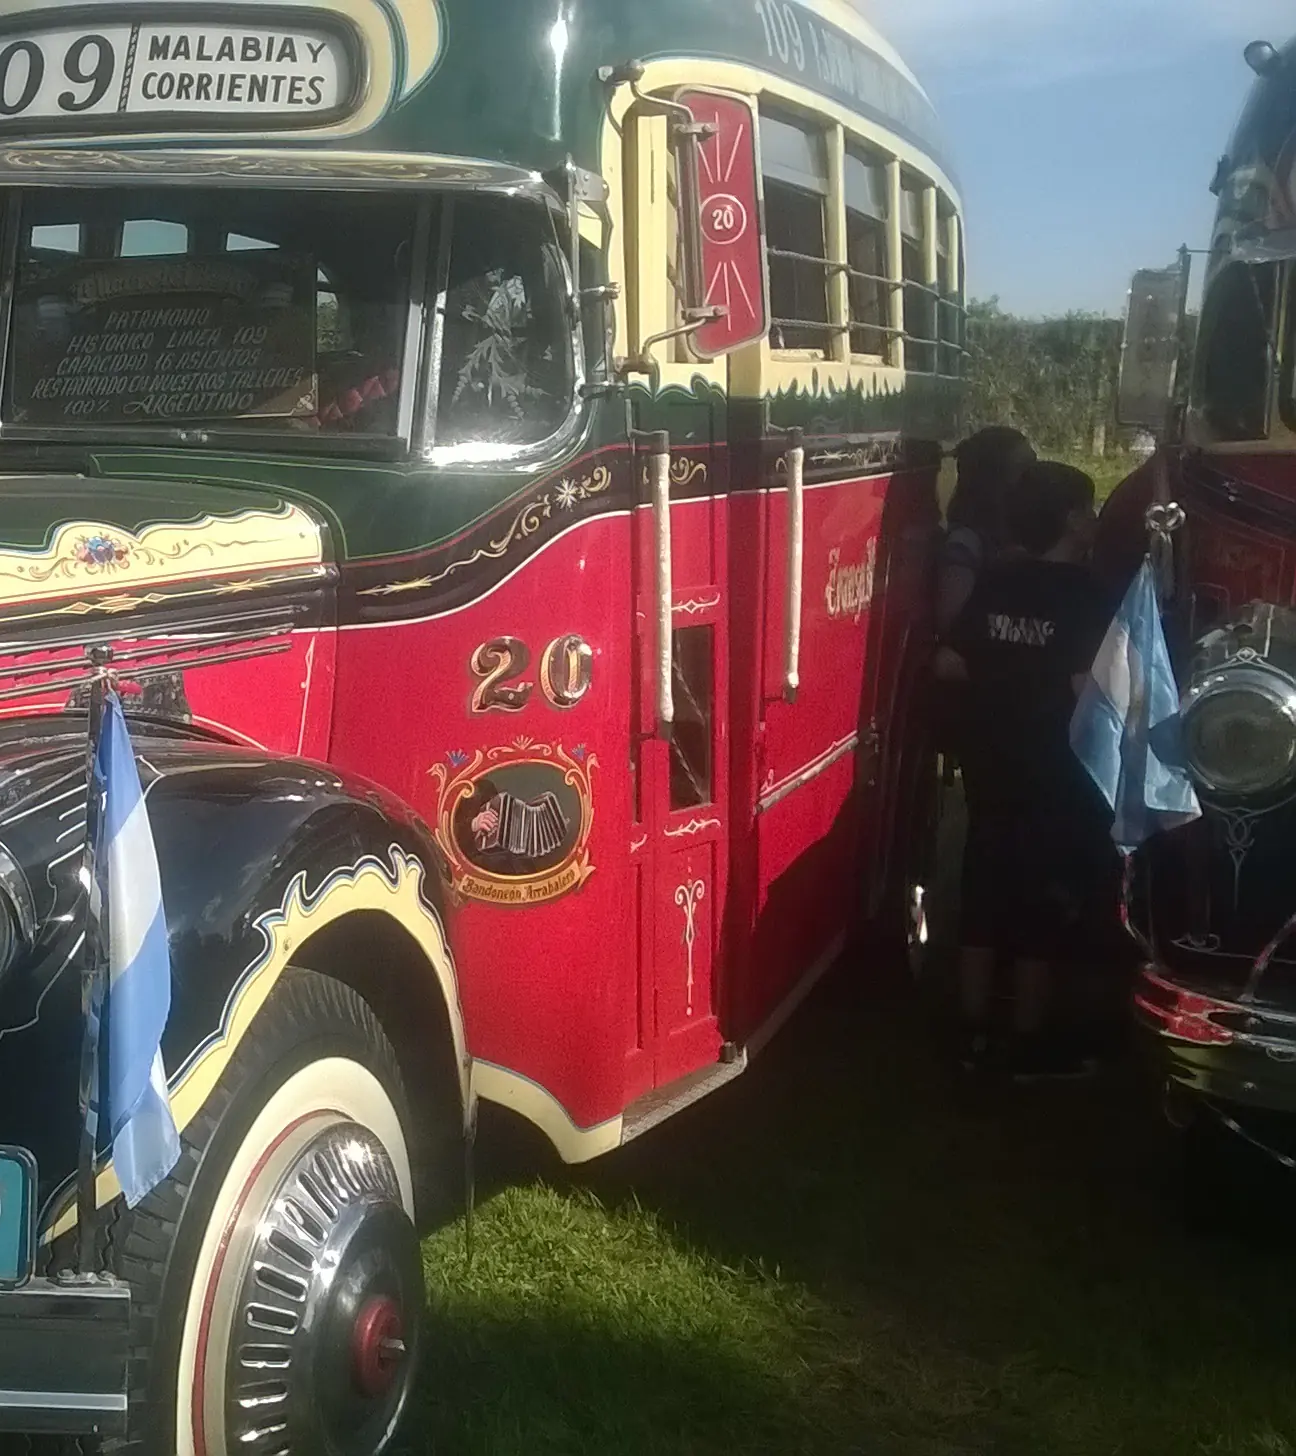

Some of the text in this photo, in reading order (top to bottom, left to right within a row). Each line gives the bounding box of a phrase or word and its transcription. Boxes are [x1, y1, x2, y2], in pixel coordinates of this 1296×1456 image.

[149, 34, 326, 64] MALABIA Y
[141, 71, 326, 106] CORRIENTES
[712, 206, 735, 231] 20
[104, 307, 211, 330] PATRIMONIO
[166, 328, 222, 349] LINEA
[232, 326, 268, 346] 109
[56, 353, 146, 376] CAPACIDAD
[153, 352, 174, 372] 16
[31, 375, 128, 400] RESTAURADO
[150, 369, 227, 393] NUESTROS
[228, 365, 303, 389] TALLERES
[122, 392, 255, 417] ARGENTINO
[469, 634, 595, 713] 20
